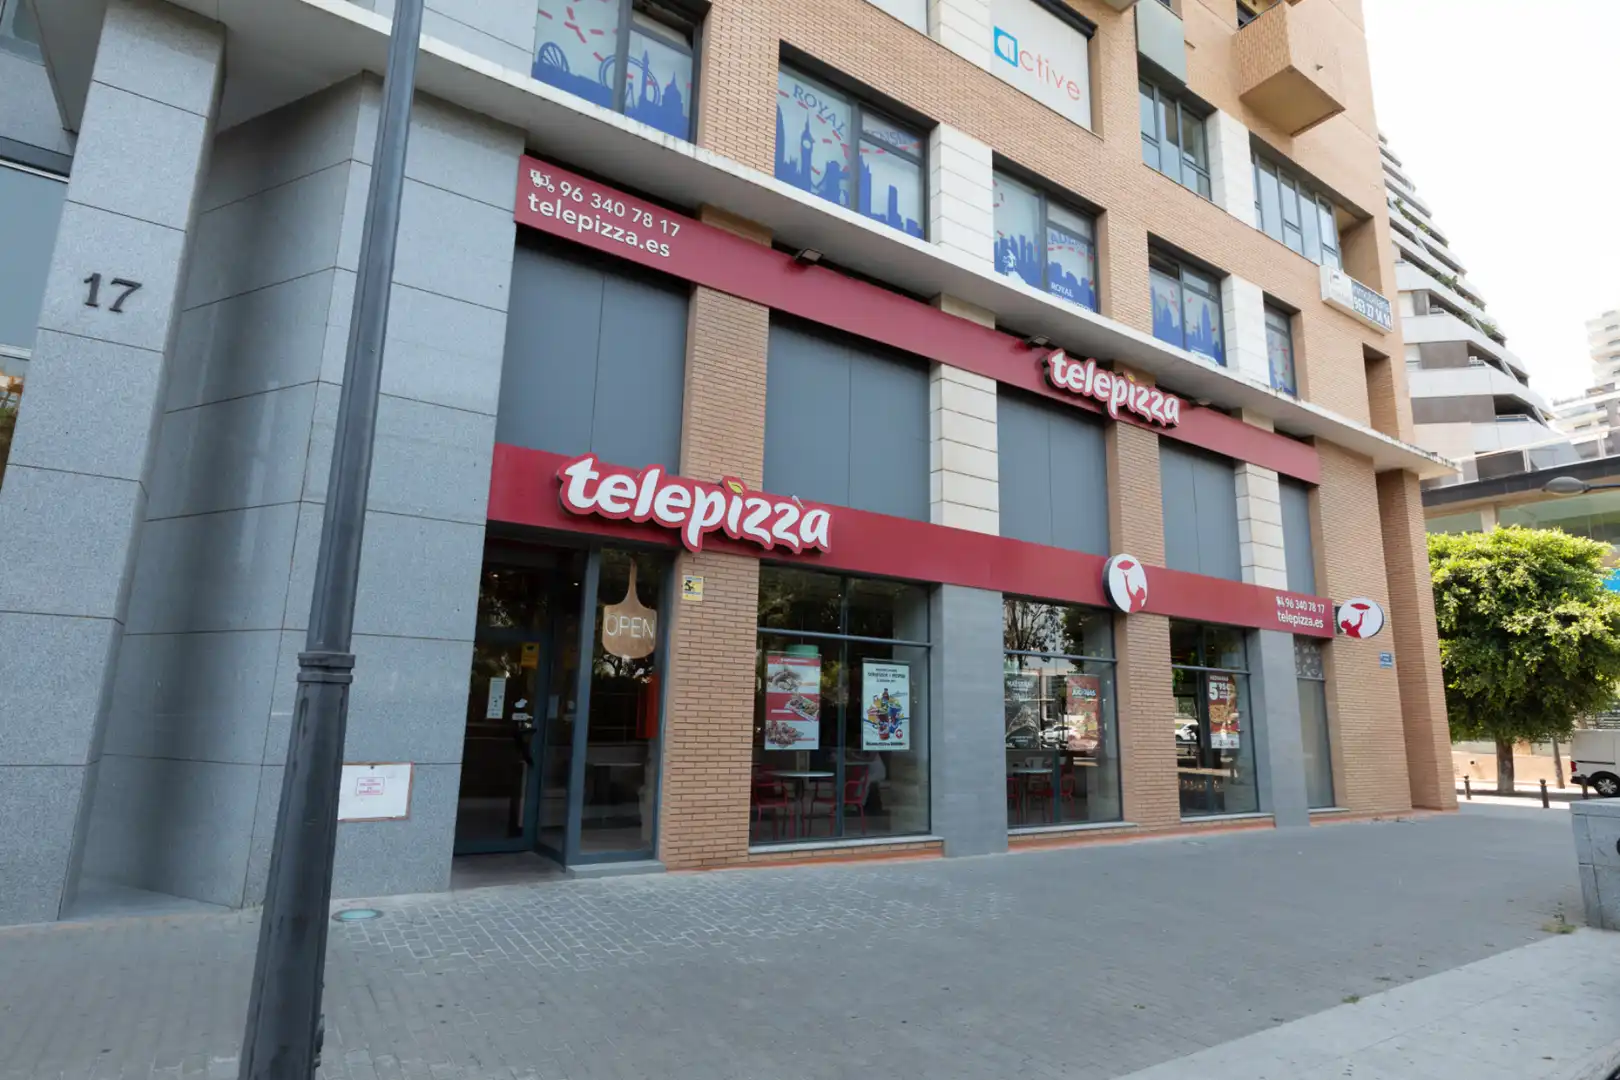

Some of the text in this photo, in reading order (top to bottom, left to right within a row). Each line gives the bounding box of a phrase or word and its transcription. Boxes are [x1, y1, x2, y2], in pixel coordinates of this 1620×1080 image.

[792, 84, 849, 138] ROYAL
[527, 192, 671, 258] telepizza.es
[559, 180, 681, 237] 96 340 78 17
[83, 272, 143, 314] 17
[1050, 350, 1181, 425] telepizza
[563, 456, 833, 549] telepizza
[605, 614, 655, 639] OPEN
[1277, 609, 1325, 629] telepizza.es
[1285, 597, 1325, 615] 96 340 78 17
